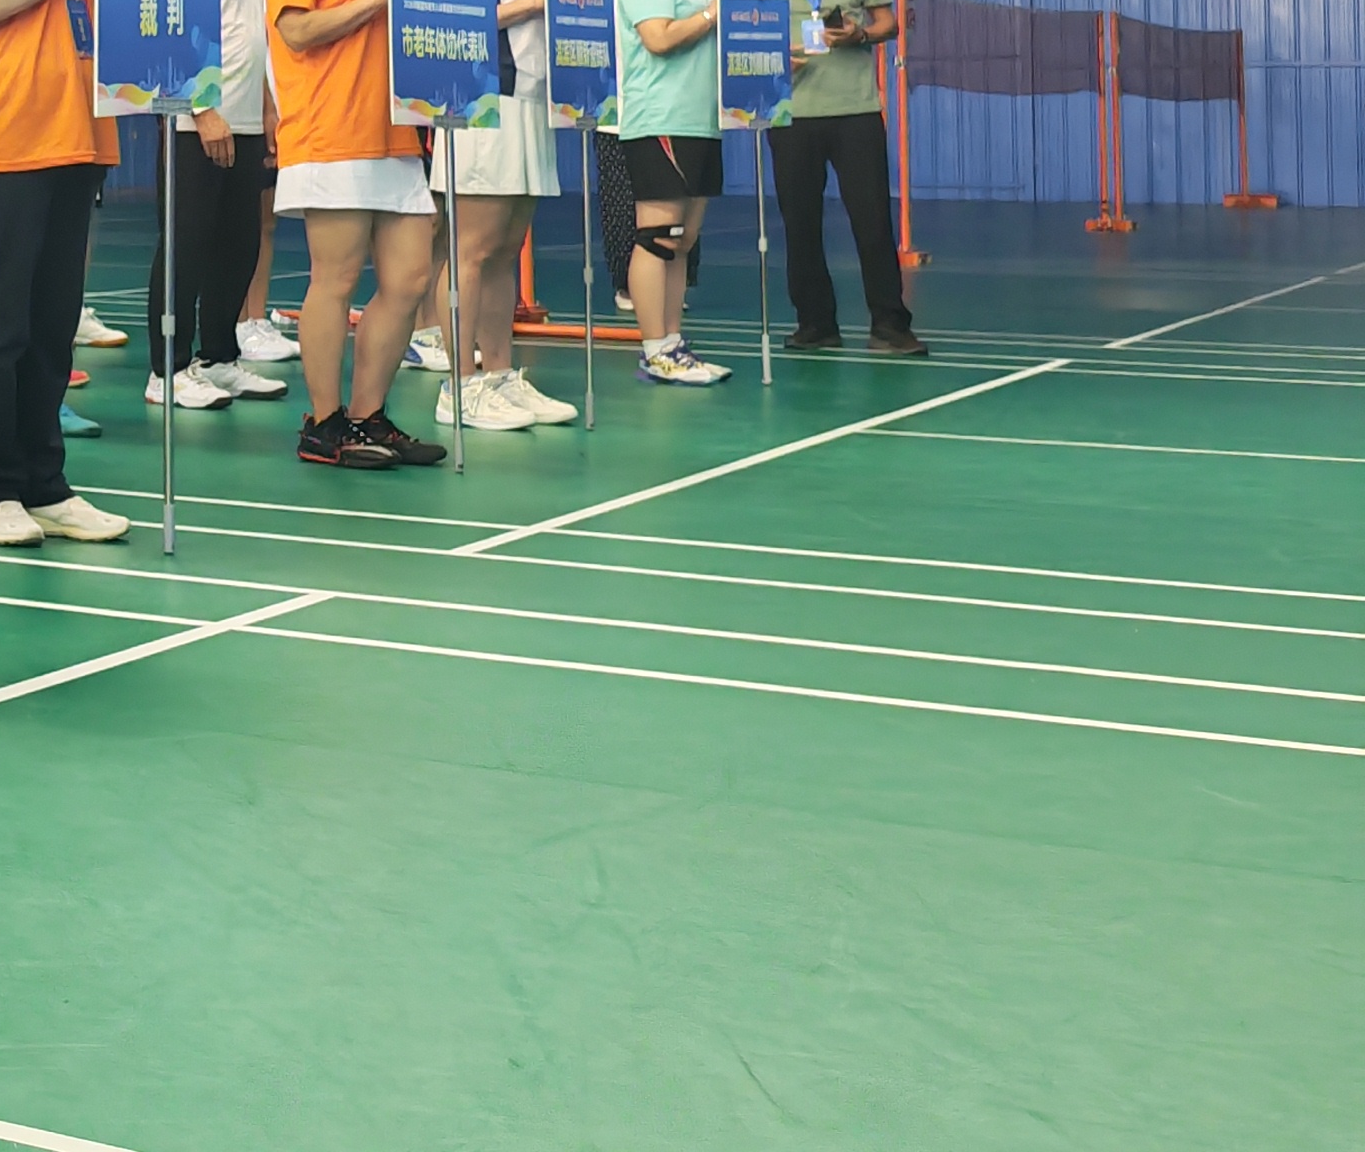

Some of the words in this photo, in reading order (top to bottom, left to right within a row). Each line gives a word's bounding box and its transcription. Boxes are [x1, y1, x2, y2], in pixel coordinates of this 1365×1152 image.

[401, 23, 489, 62] 市老年体协代表队
